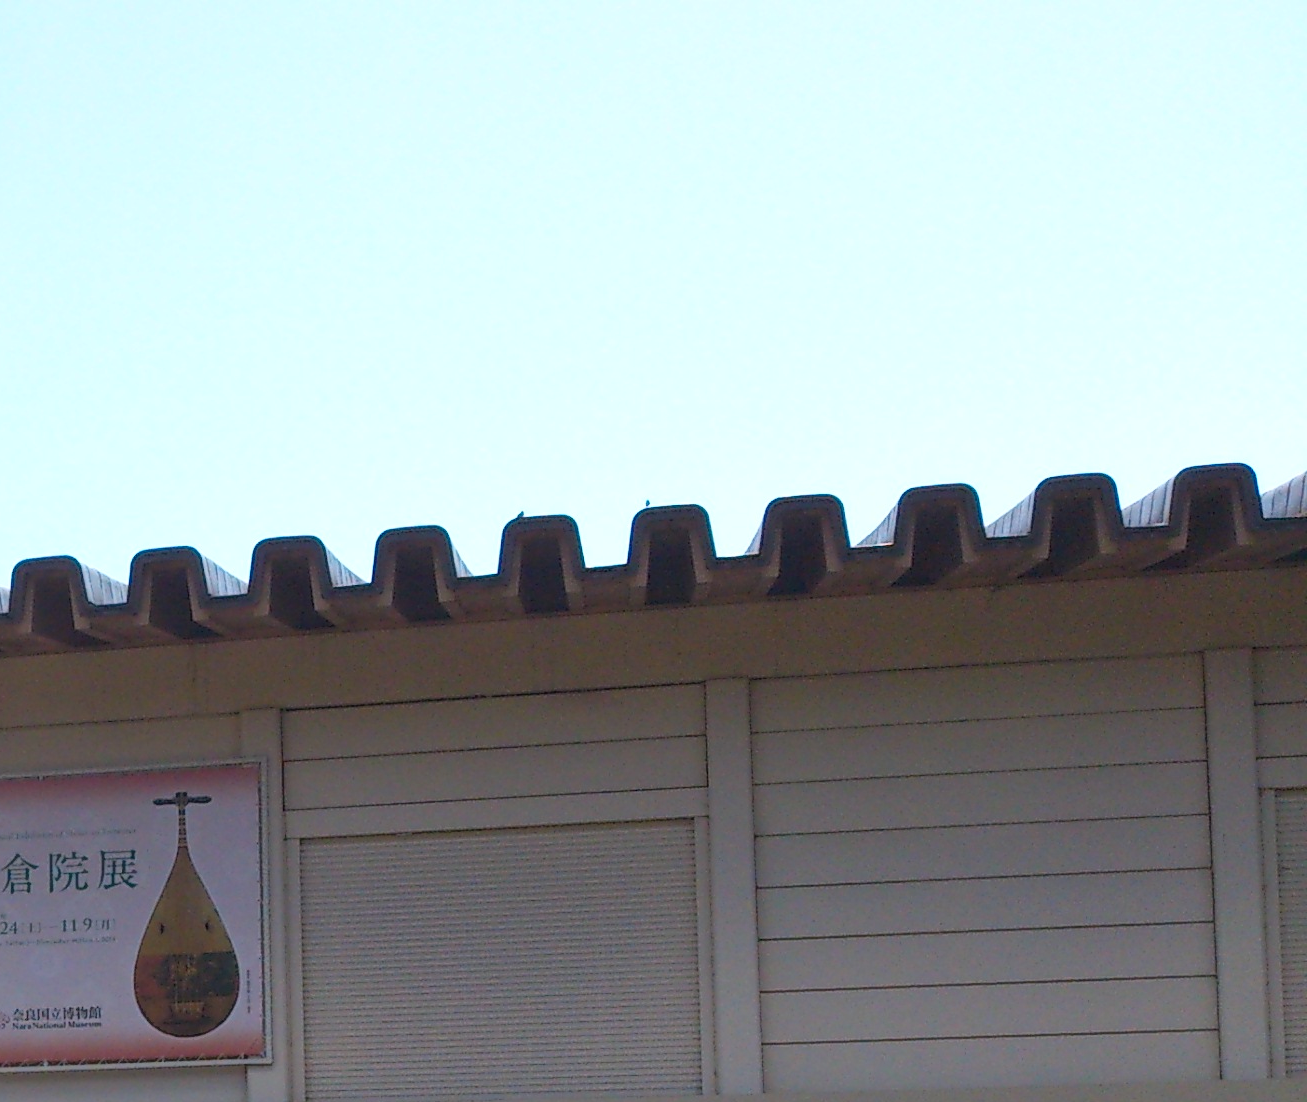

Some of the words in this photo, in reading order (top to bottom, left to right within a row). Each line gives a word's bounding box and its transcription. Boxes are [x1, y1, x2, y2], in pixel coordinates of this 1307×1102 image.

[12, 1022, 32, 1030] Nara
[32, 1021, 66, 1029] National
[68, 1020, 102, 1028] Museum
